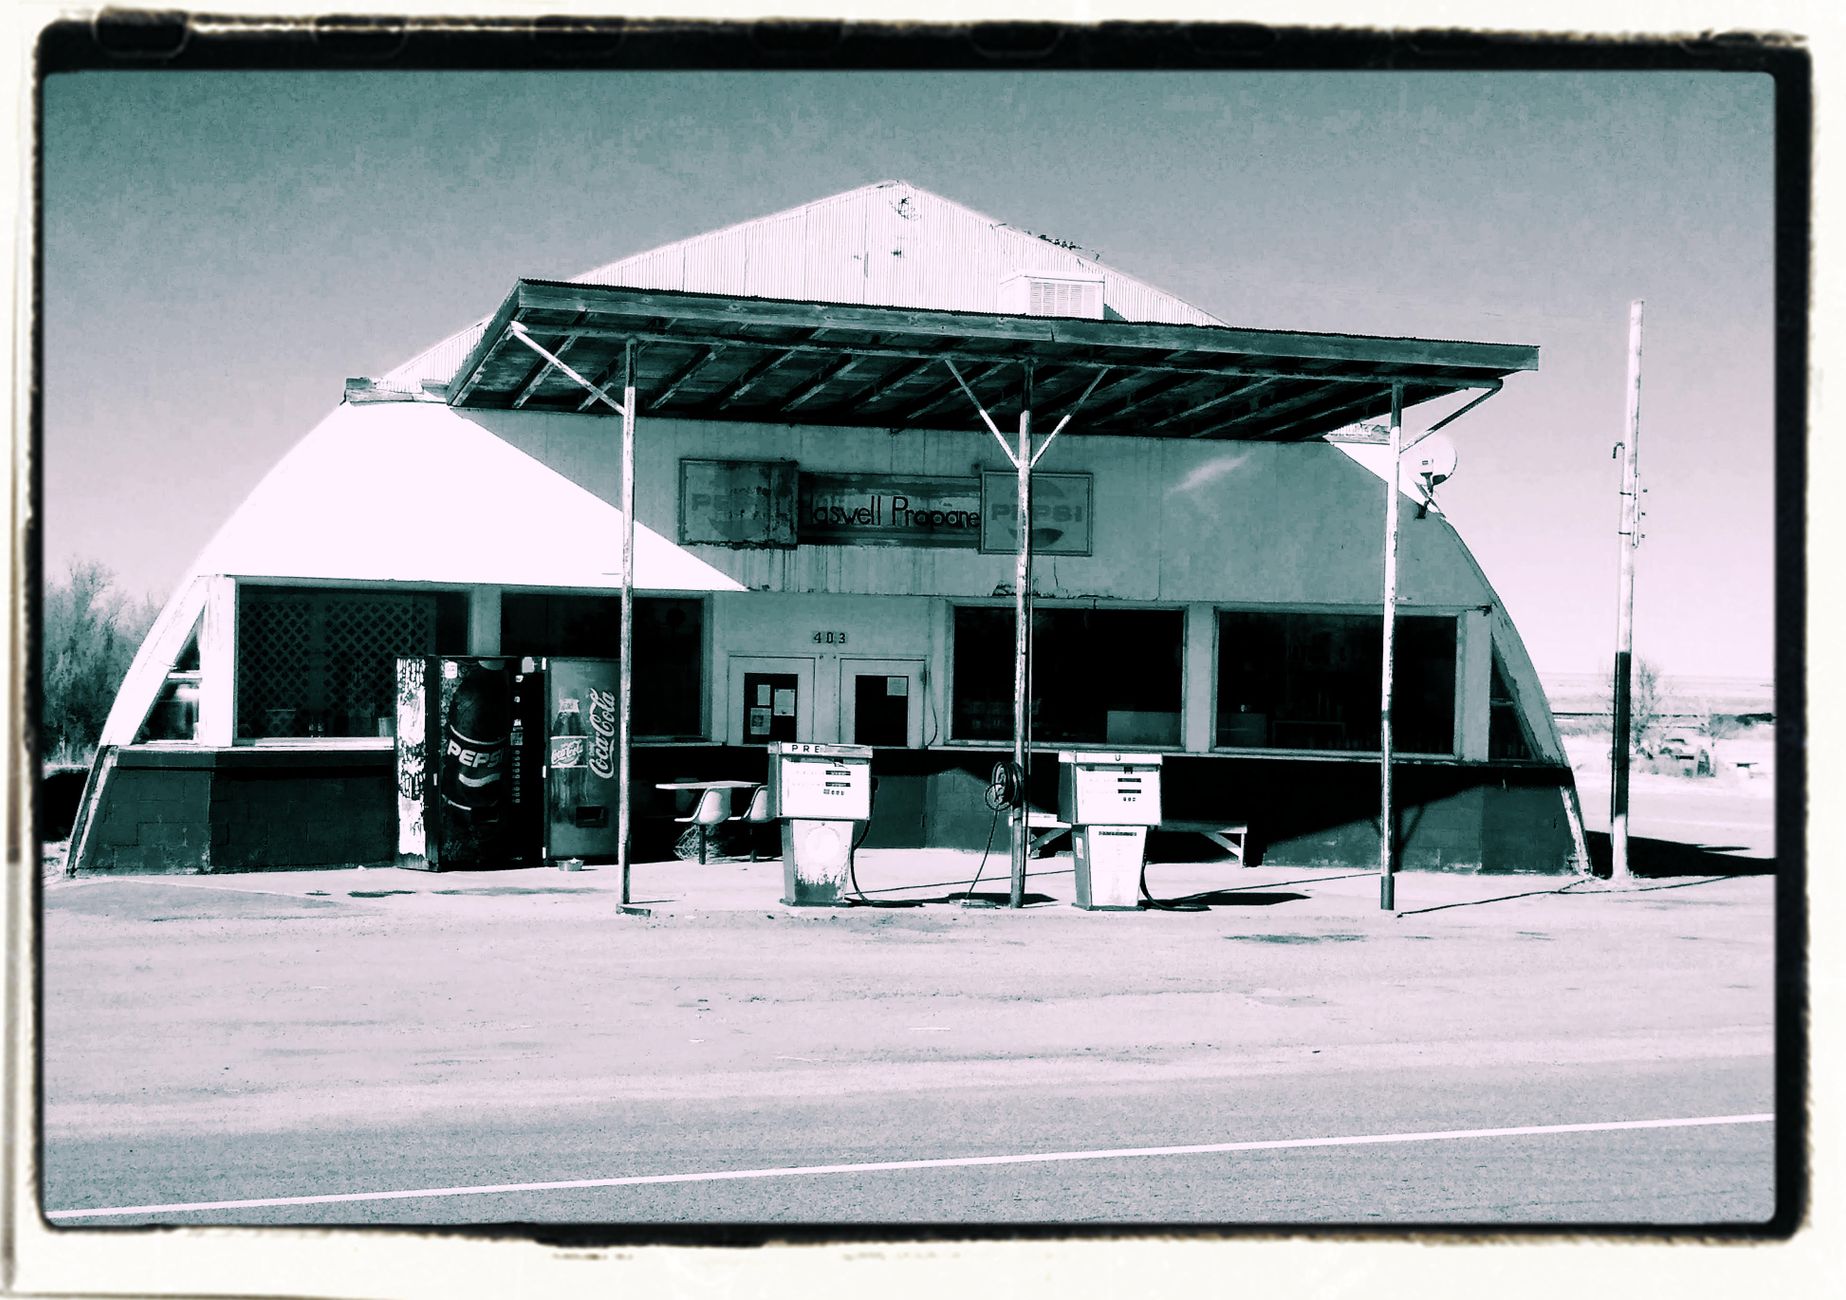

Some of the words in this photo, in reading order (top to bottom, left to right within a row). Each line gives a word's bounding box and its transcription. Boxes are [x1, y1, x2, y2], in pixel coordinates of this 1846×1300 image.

[892, 496, 980, 530] Propane
[813, 631, 846, 644] 403
[447, 739, 504, 768] PEPS
